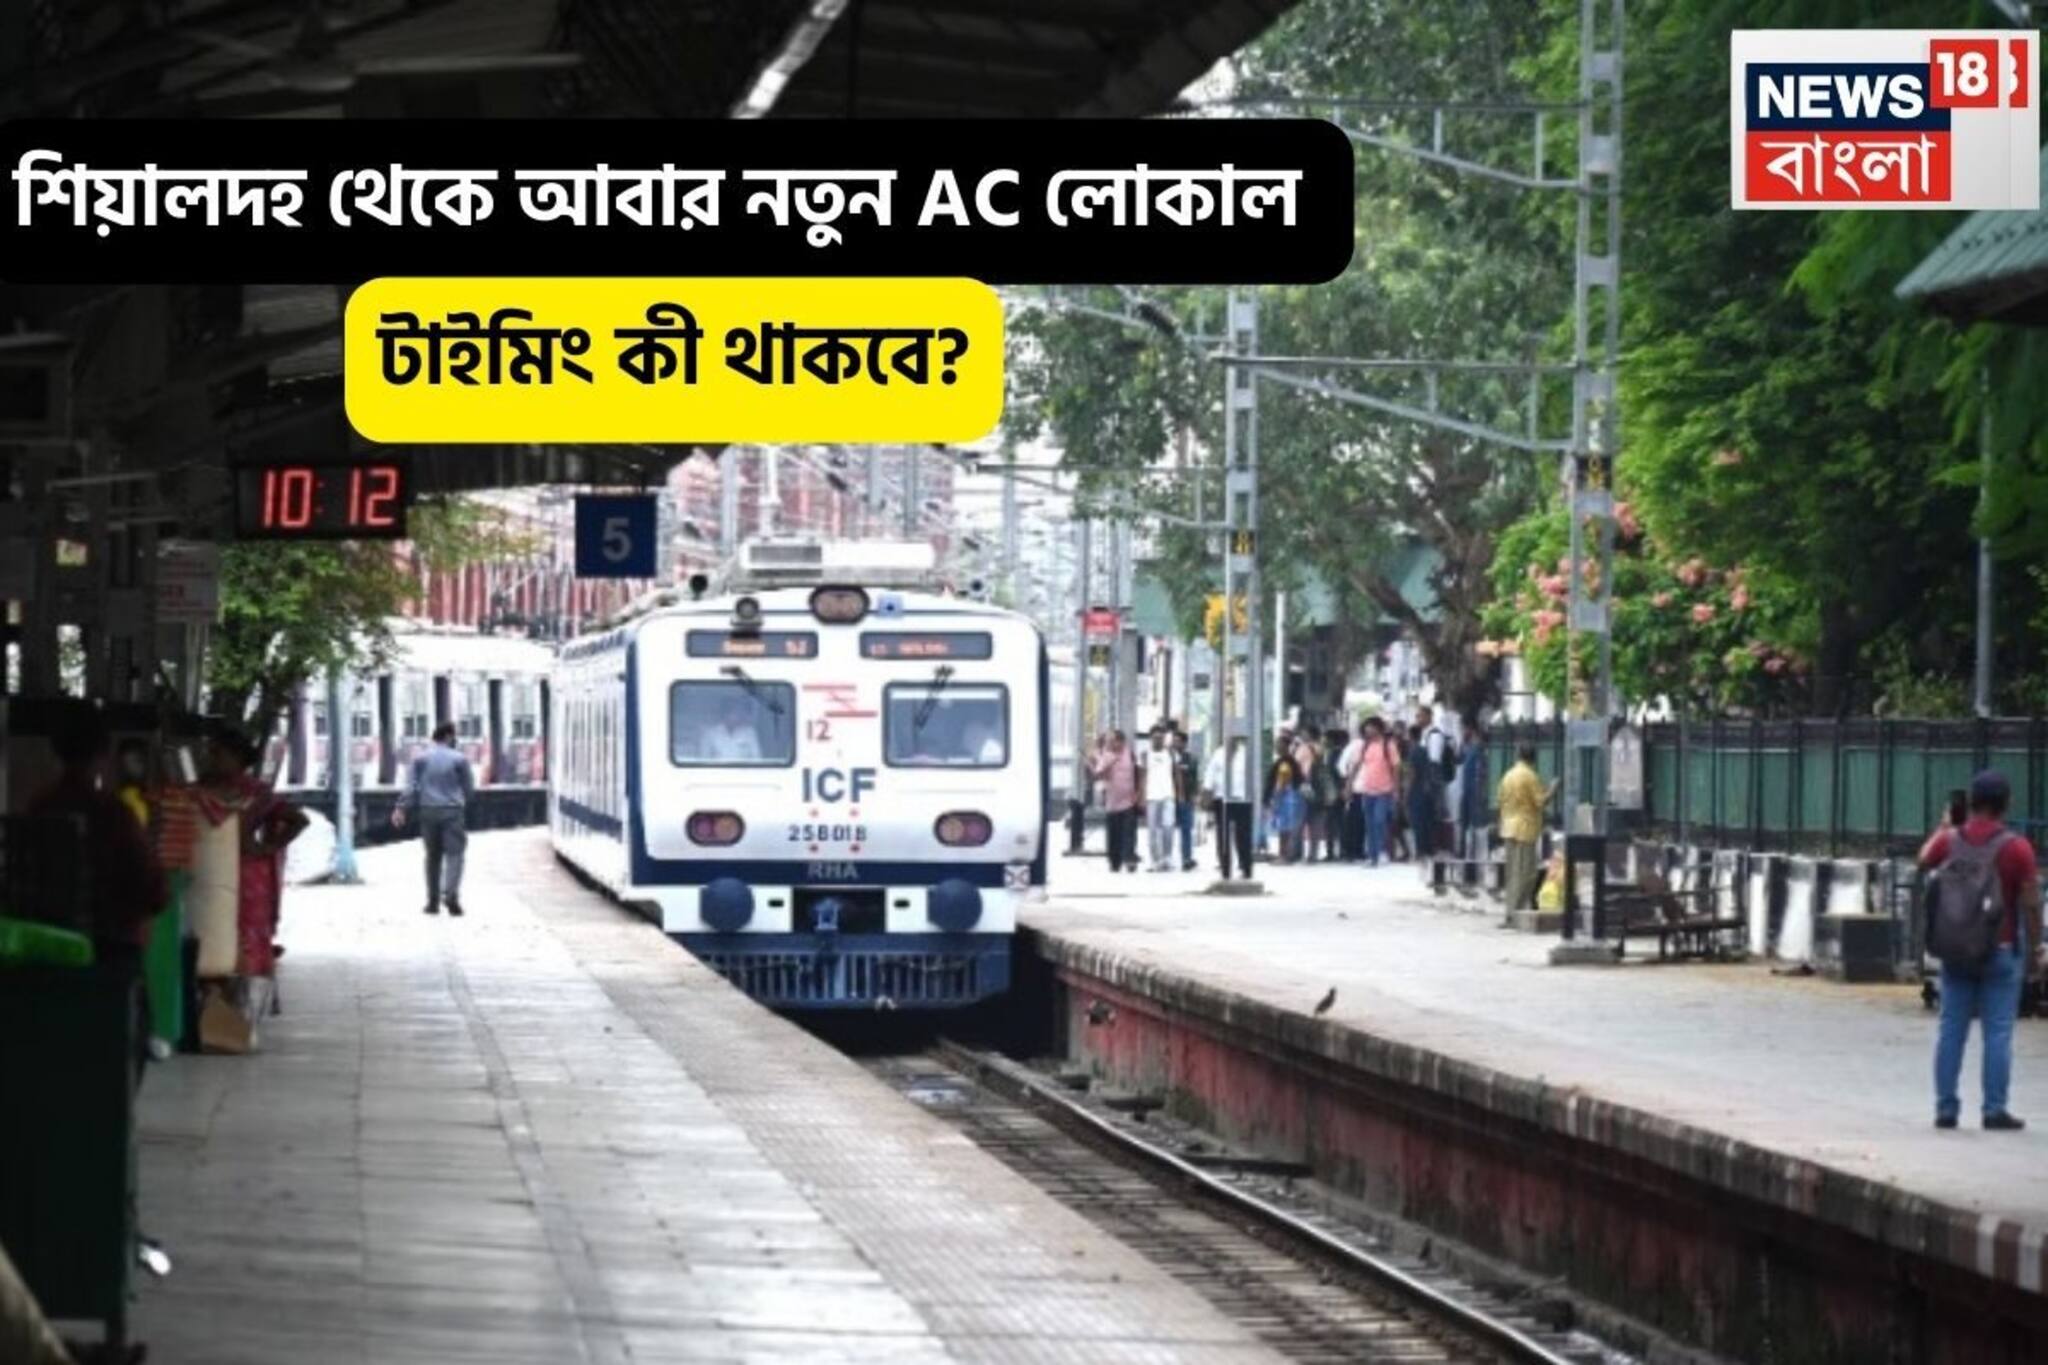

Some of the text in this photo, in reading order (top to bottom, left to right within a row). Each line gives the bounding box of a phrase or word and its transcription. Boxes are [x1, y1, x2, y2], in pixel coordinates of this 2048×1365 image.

[602, 518, 630, 562] 5
[806, 719, 832, 742] 12
[802, 768, 878, 804] ICF
